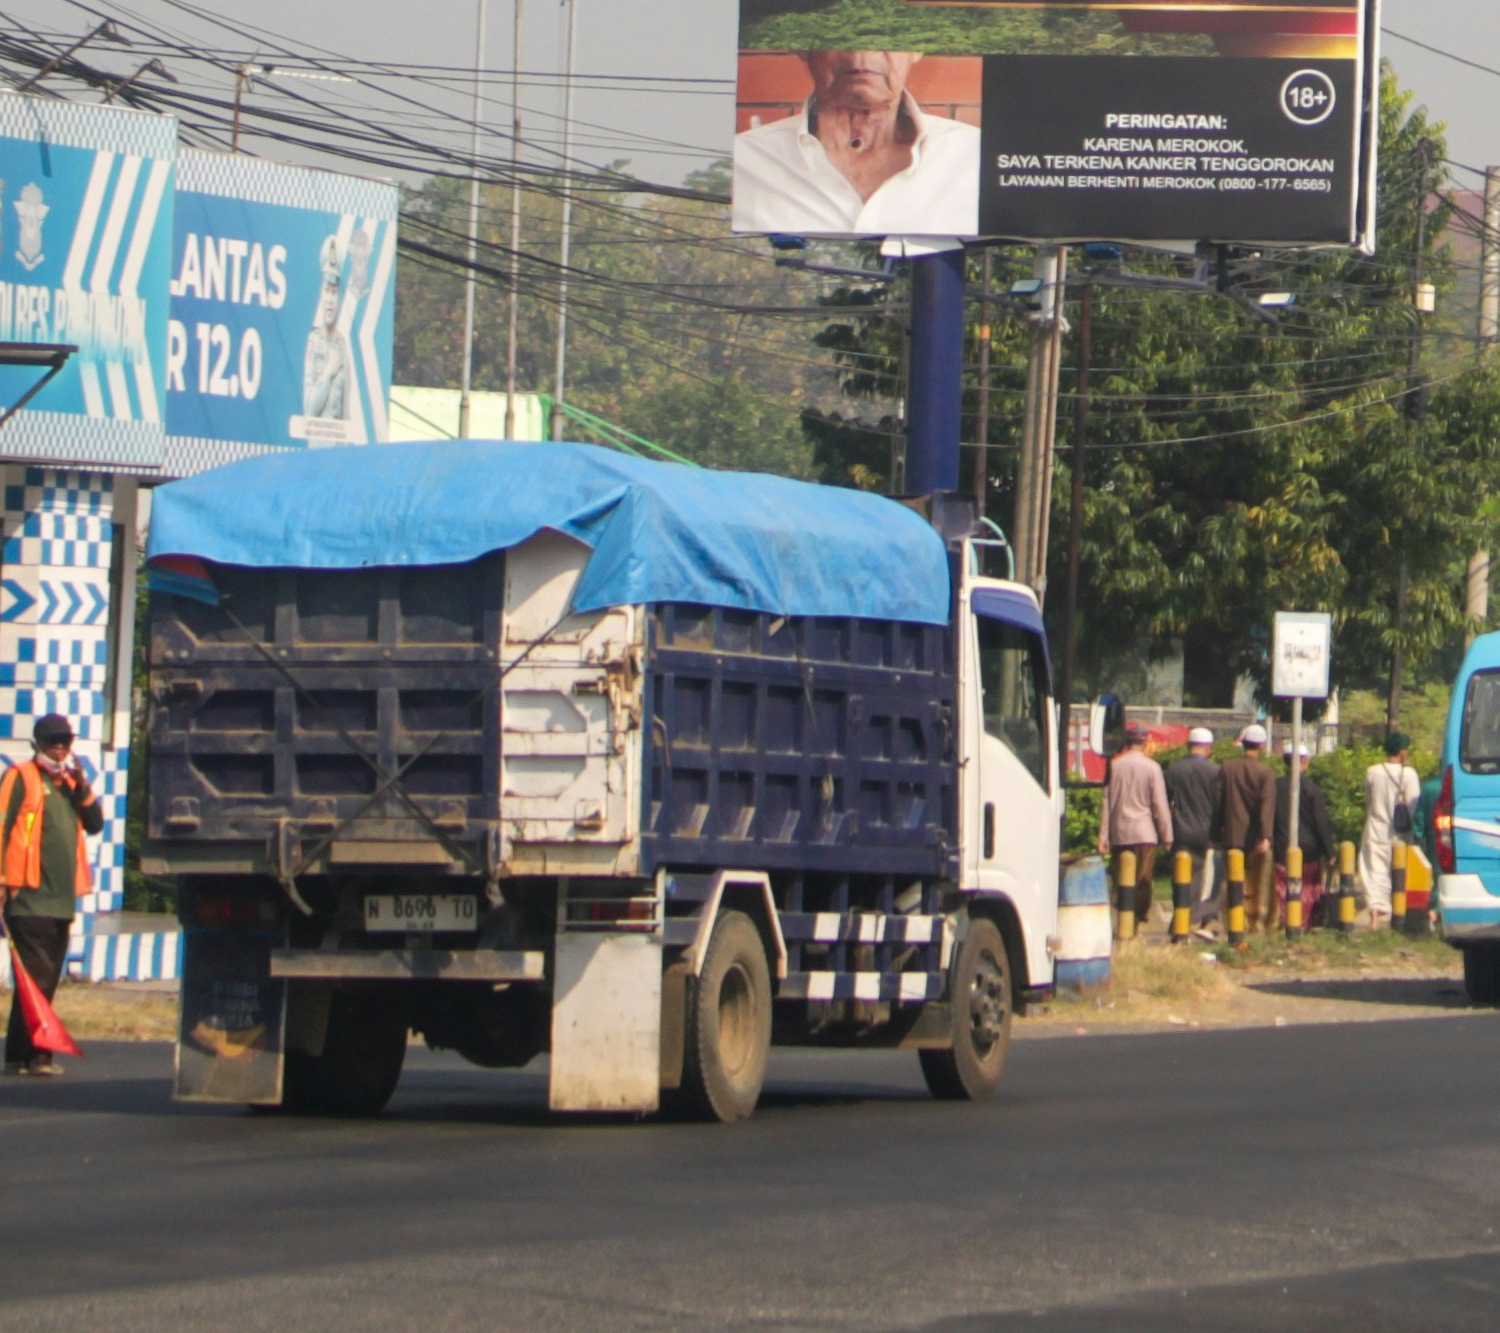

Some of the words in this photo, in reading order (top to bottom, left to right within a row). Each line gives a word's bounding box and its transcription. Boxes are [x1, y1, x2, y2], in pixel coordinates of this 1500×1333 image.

[1288, 86, 1328, 109] 18+
[1105, 113, 1228, 131] PERINGATAN:
[1083, 137, 1154, 153] KARENA
[1156, 139, 1249, 155] MEROKOK,
[997, 154, 1041, 170] SAYA
[1043, 156, 1124, 171] TERKENA
[1127, 157, 1197, 171] KANKER
[1200, 158, 1335, 173] TENGGOROKAN
[999, 174, 1064, 188] LAYANAN
[1067, 175, 1140, 189] BERHENTI
[1143, 177, 1217, 191] MEROKOK
[171, 232, 288, 310] ANTAS
[196, 322, 263, 401] 12.0
